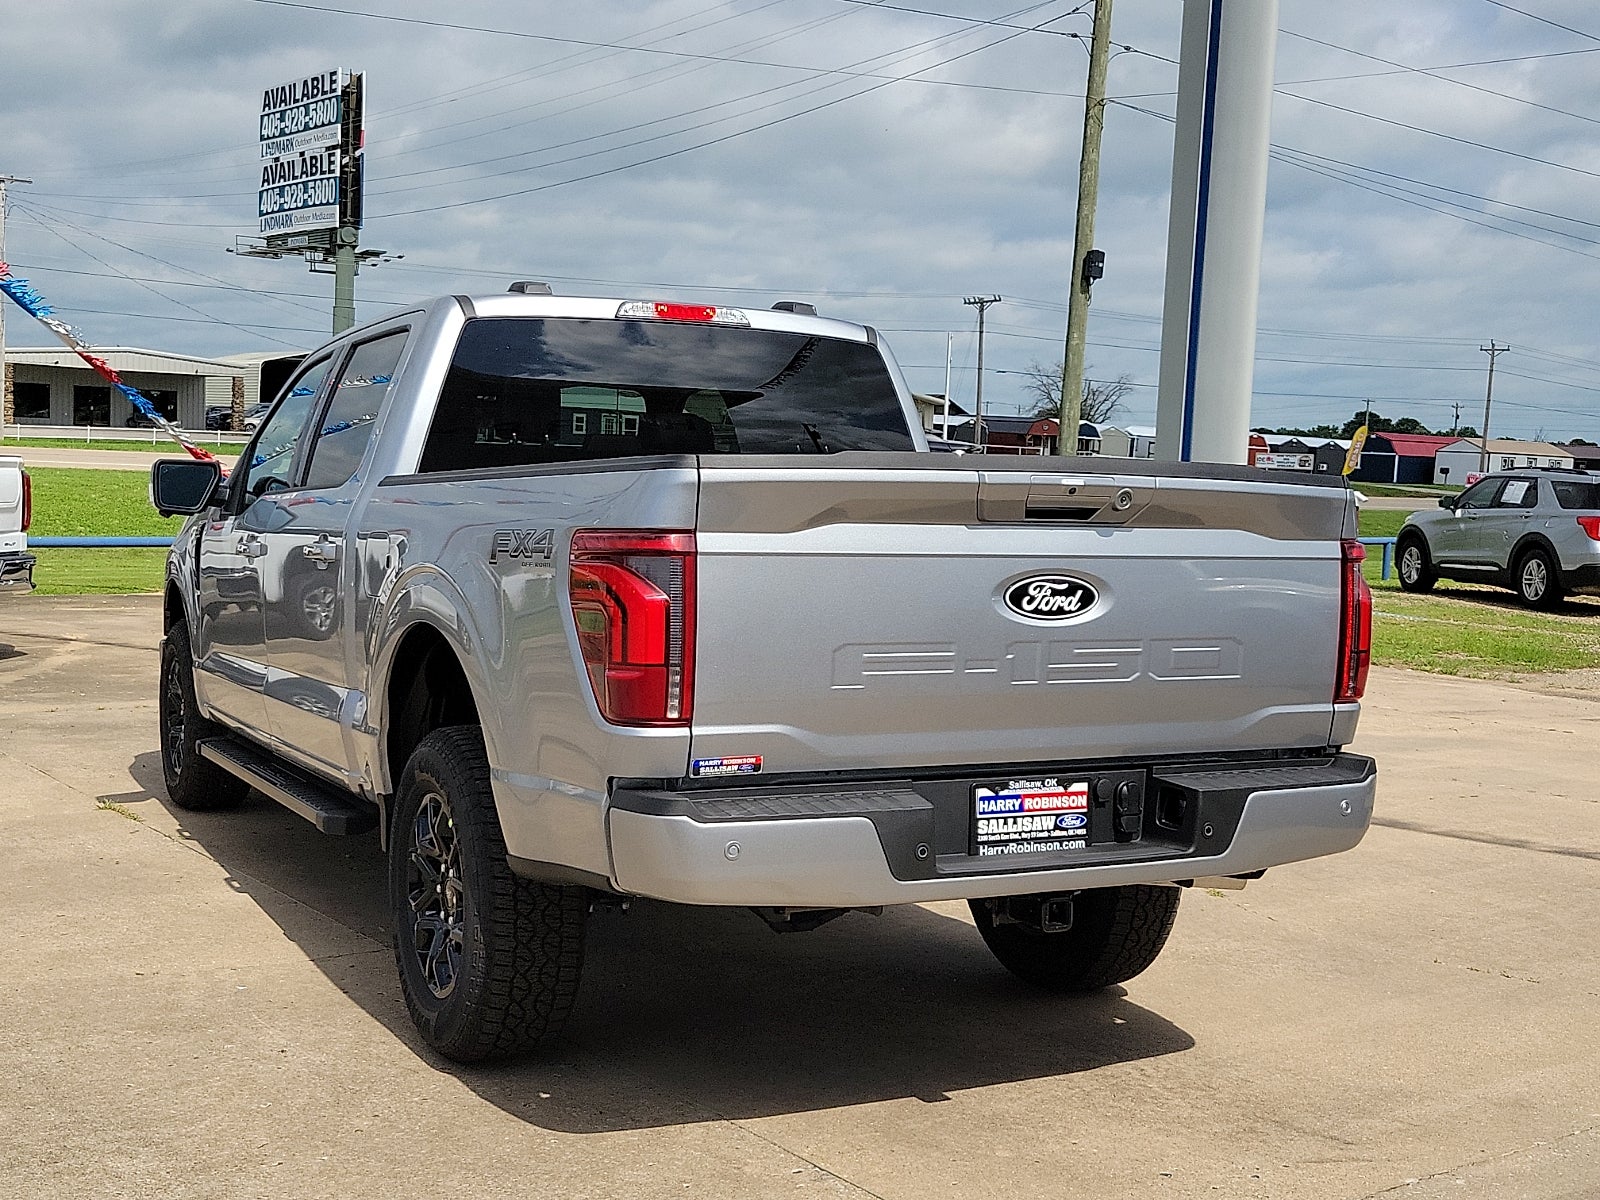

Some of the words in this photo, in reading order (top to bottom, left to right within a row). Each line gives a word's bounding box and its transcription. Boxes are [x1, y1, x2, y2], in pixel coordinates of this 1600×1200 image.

[262, 70, 338, 113] AVAILABLE
[260, 97, 338, 139] 405-928-5800
[261, 151, 336, 188] AVAILABLE
[260, 178, 336, 214] 405-928-5800
[489, 528, 555, 565] FX4
[1021, 580, 1082, 613] Ford
[830, 637, 1243, 690] F-150
[699, 765, 739, 773] SALLISAW
[1009, 779, 1044, 789] Sallisaw,
[1044, 778, 1058, 787] OK
[979, 798, 1022, 812] HARRY
[1023, 795, 1088, 810] ROBINSON
[977, 815, 1057, 835] SALLISAW
[1060, 816, 1082, 826] Ford
[979, 839, 1086, 857] HarryRobinson.com
